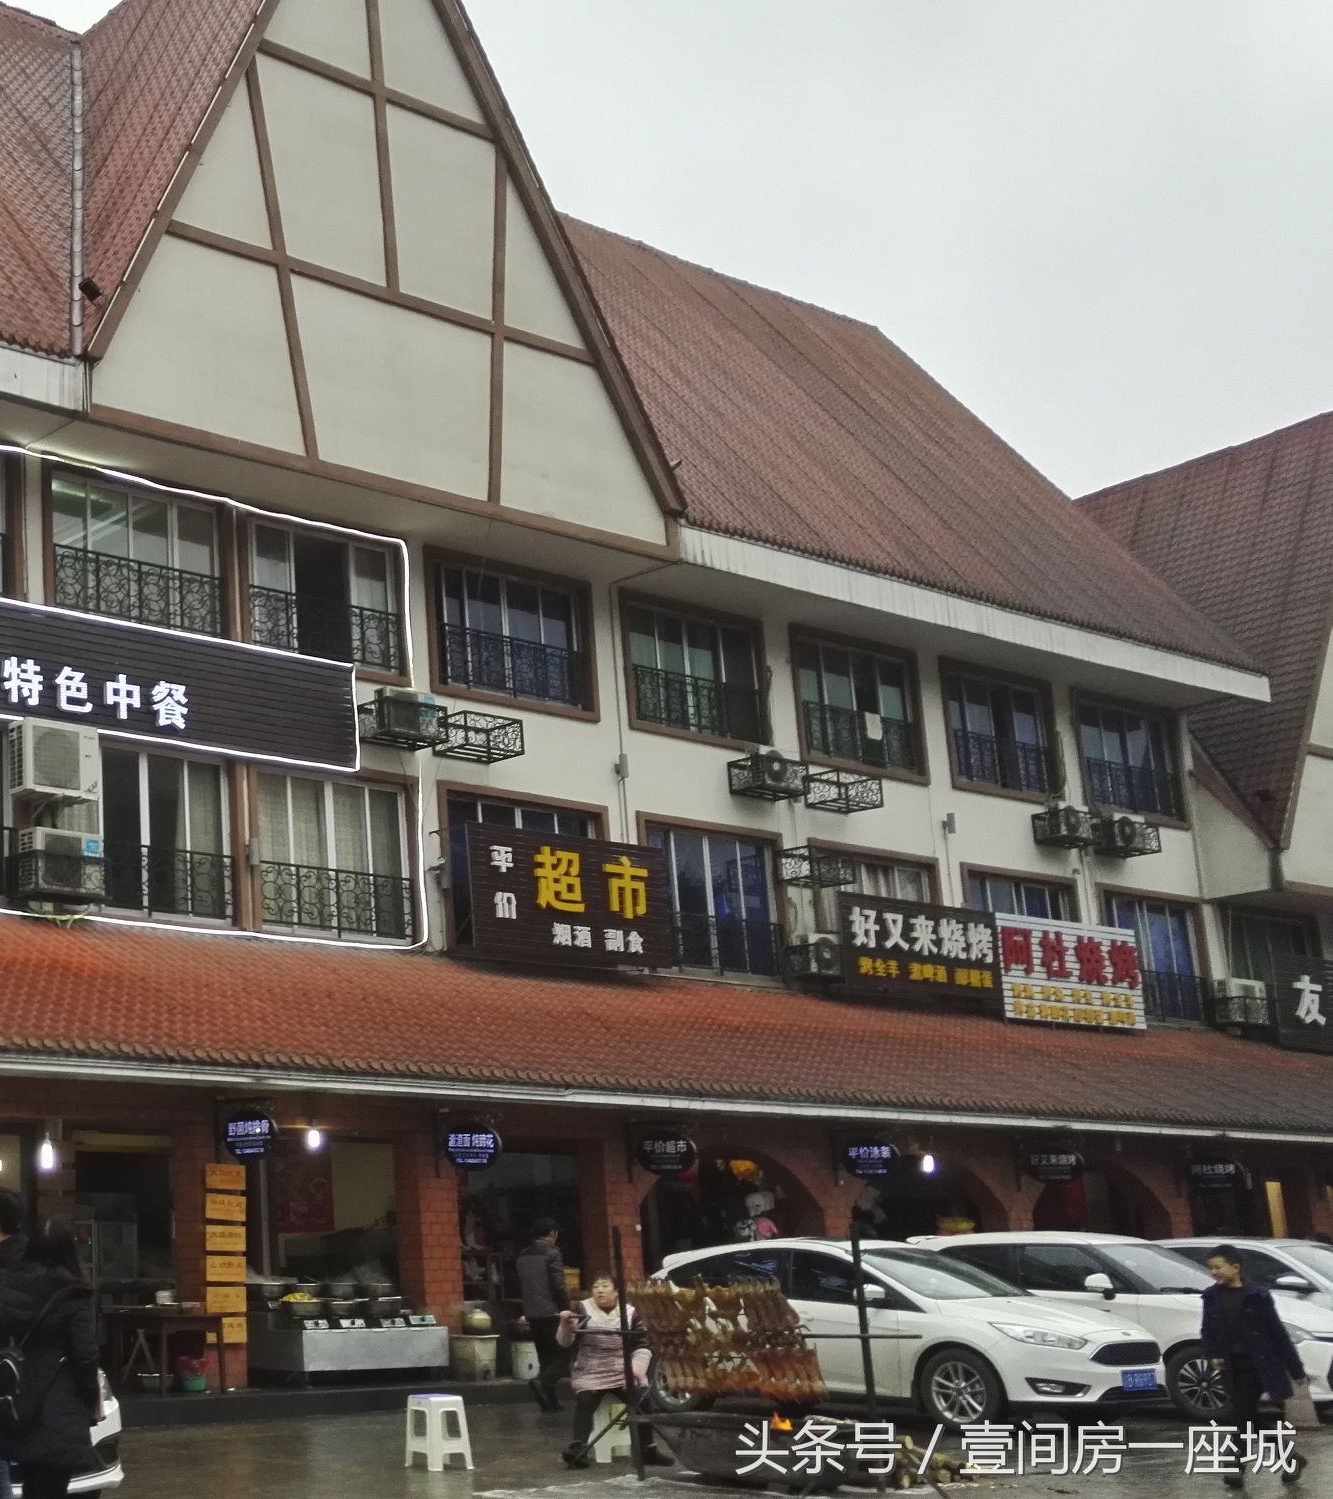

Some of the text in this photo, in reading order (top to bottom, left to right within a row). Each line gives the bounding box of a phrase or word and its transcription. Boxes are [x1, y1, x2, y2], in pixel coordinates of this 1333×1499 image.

[0, 655, 190, 732] 特色中餐
[490, 845, 517, 920] 平价
[533, 845, 649, 920] 超市
[552, 921, 644, 954] 烟酒 副食
[849, 906, 994, 964] 好又来烧烤
[1292, 975, 1327, 1026] 友
[643, 1140, 687, 1154] 平价超市
